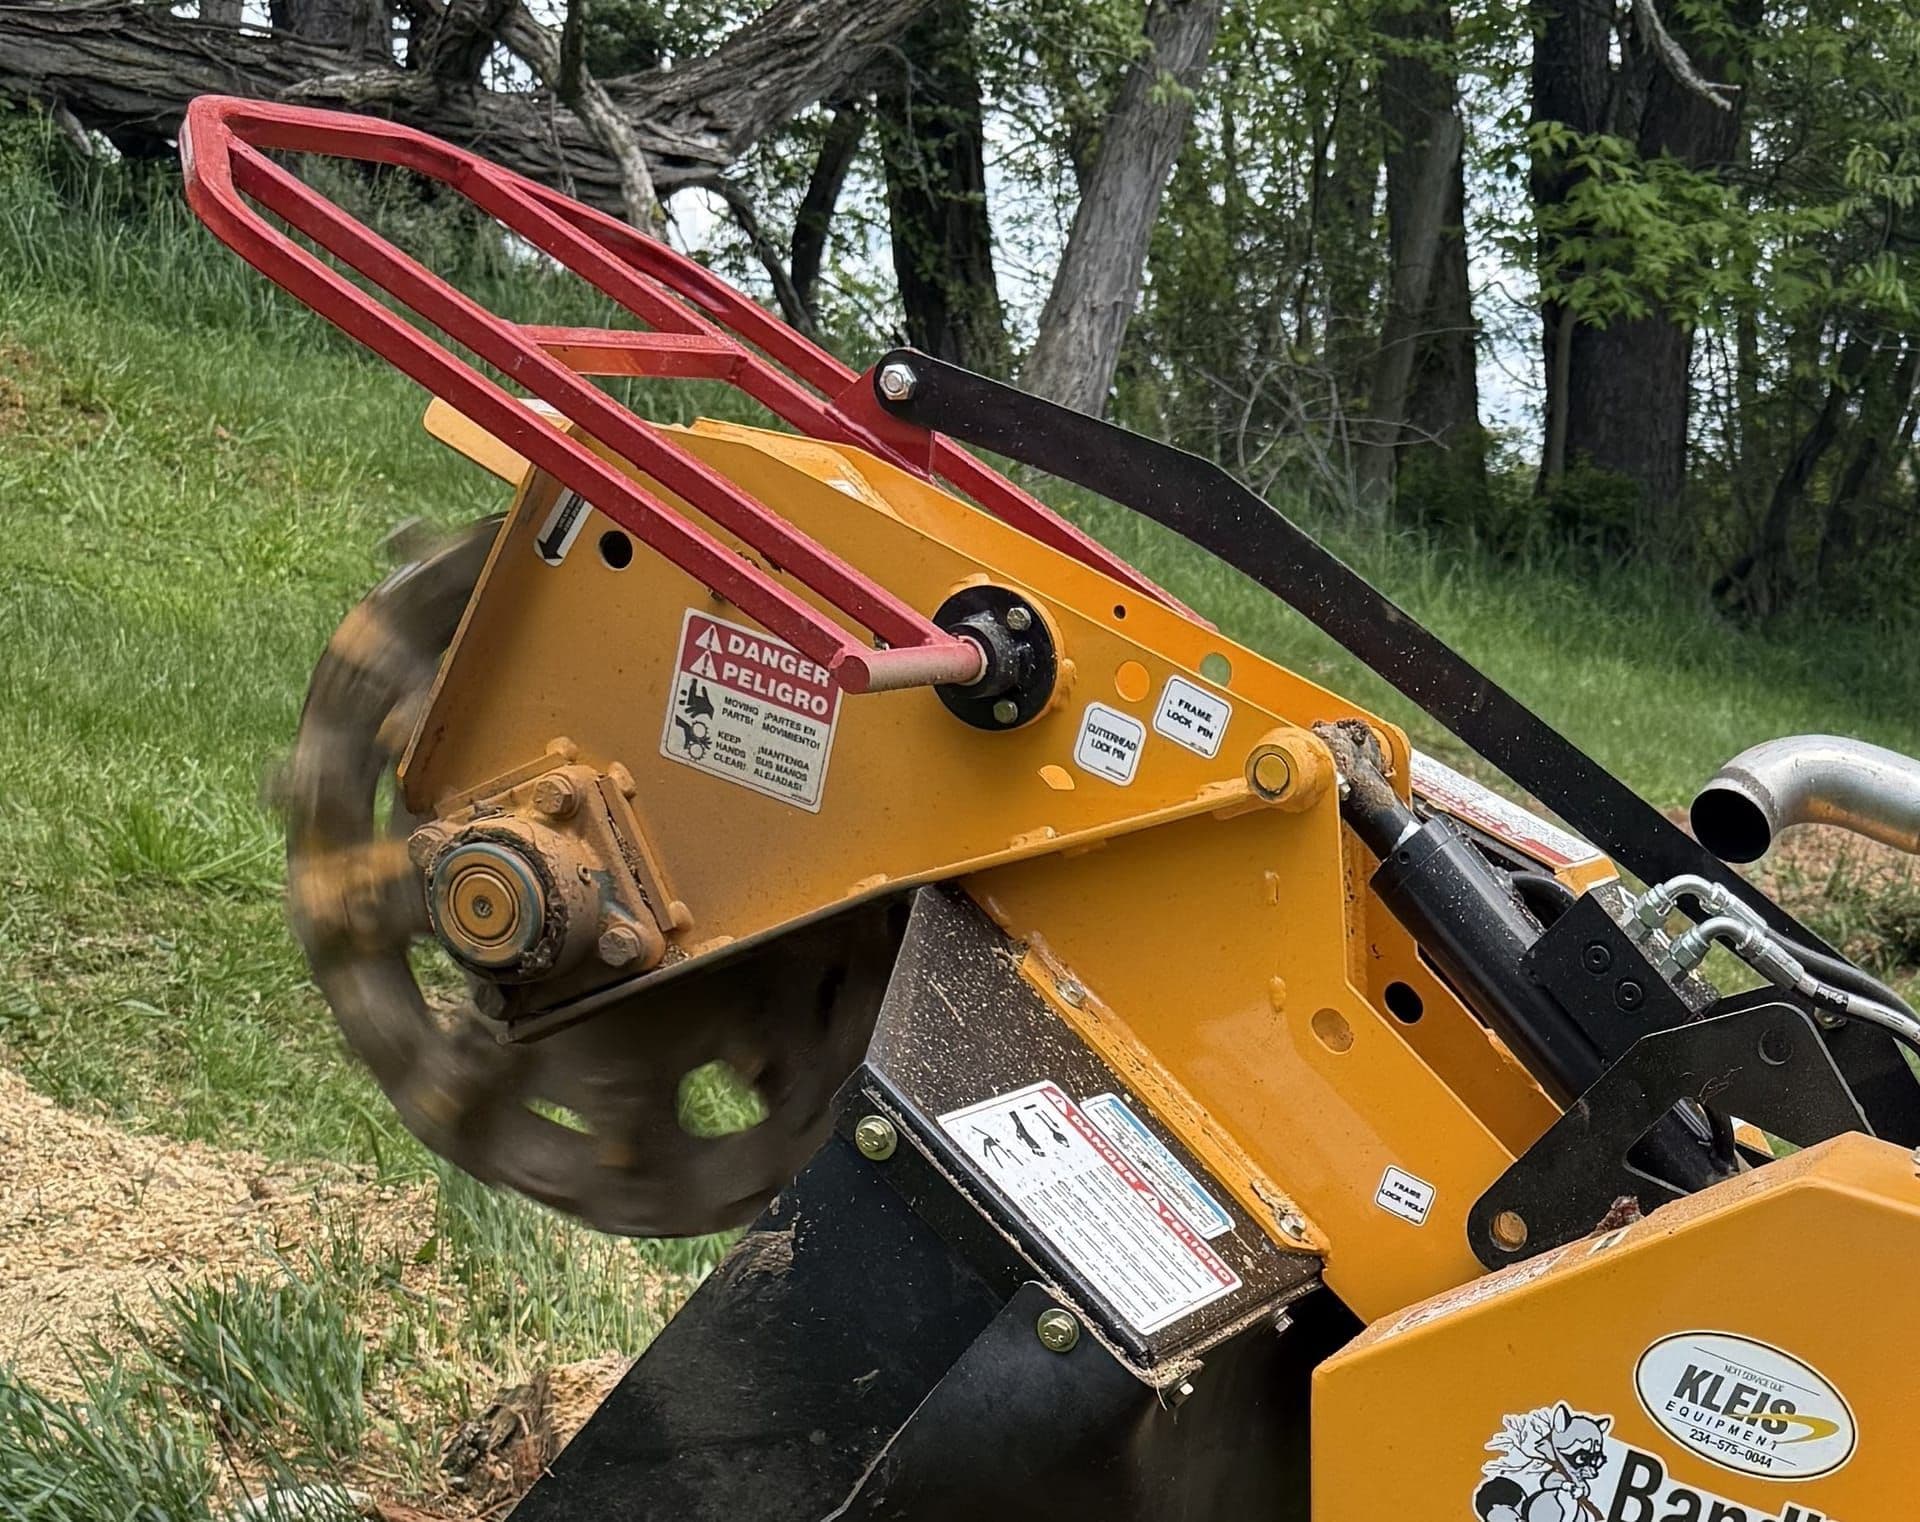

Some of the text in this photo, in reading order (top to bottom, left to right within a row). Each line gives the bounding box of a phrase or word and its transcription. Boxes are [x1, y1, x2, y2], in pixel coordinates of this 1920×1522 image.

[728, 634, 830, 687] DANGER
[722, 662, 828, 715] PELIGRO
[722, 708, 754, 725] PARTS!
[725, 696, 759, 716] MOVING
[1178, 699, 1212, 723] FRAME
[718, 730, 741, 744] KEEP
[762, 722, 820, 750] MOVIMIENTO!
[803, 725, 816, 736] EN
[1087, 723, 1137, 751] CUTTERHEAD
[1166, 709, 1213, 740] LOCK PIN
[713, 752, 746, 771] CLEAR!
[716, 741, 746, 758] HANDS
[1091, 739, 1126, 761] LOCK PIN
[754, 768, 802, 791] ALEJADAS!
[756, 756, 807, 781] SUS MANOS
[1070, 1114, 1139, 1186] DANGER
[1162, 1210, 1231, 1282] PELIGRO
[1673, 1364, 1797, 1435] KLEIS
[1665, 1400, 1778, 1451] EQUIPMENT
[1689, 1428, 1773, 1468] 234-575-0044
